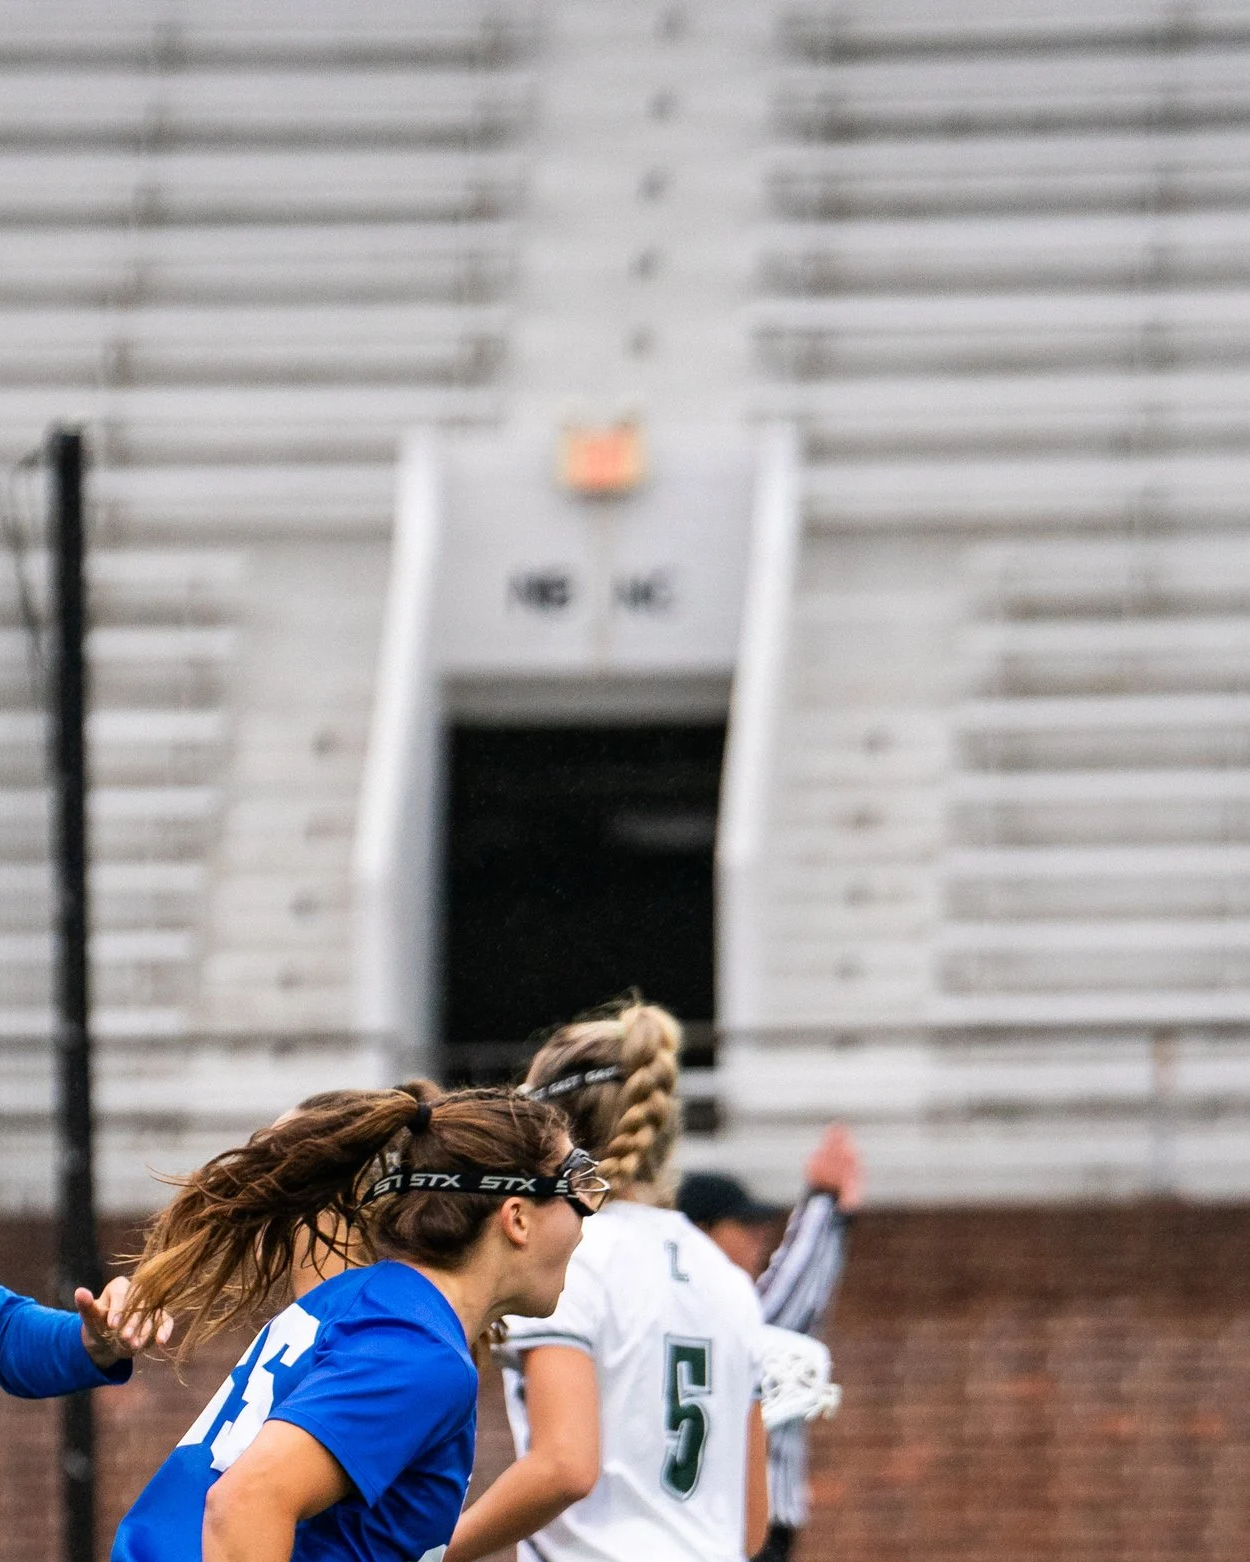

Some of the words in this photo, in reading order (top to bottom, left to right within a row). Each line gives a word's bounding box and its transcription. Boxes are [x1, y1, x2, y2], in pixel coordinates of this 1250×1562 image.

[410, 1173, 461, 1189] STX
[479, 1175, 536, 1192] STX
[660, 1333, 712, 1501] 5
